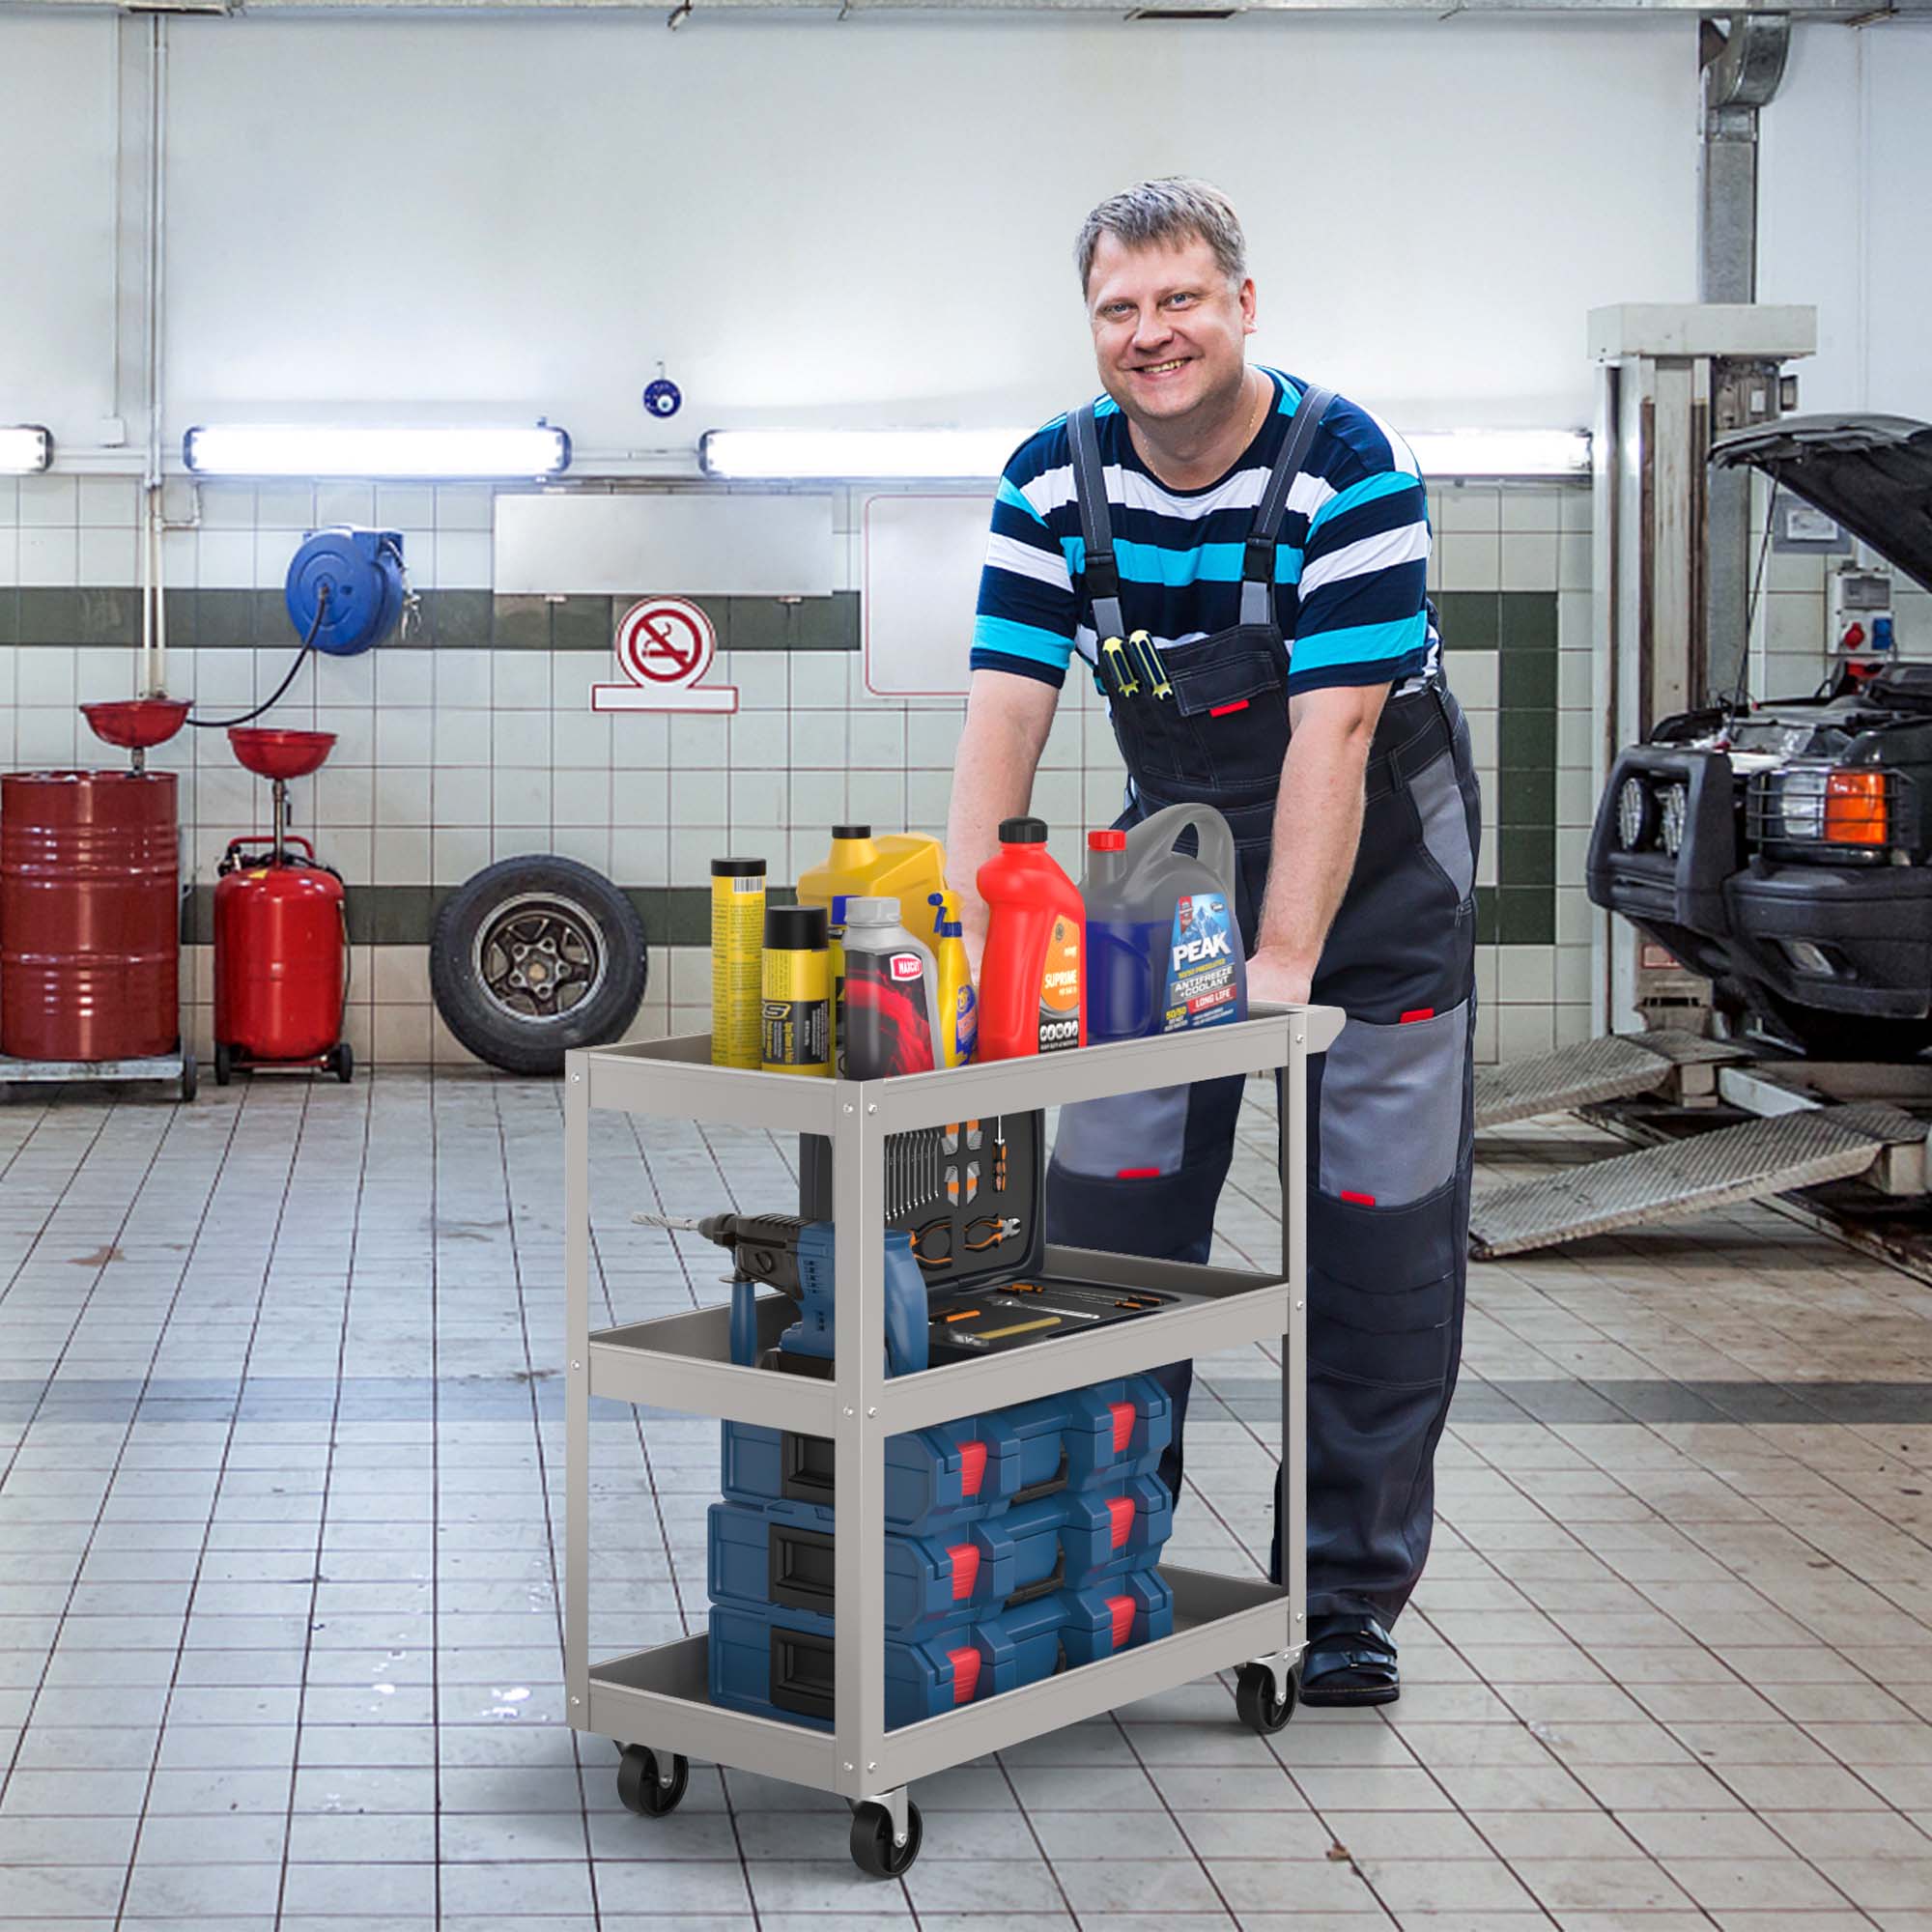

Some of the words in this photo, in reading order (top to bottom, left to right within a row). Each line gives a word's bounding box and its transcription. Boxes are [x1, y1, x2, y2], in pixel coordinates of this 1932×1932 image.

[1173, 931, 1231, 971] PEAK
[1175, 966, 1234, 992] ANTIFREEZE
[1195, 992, 1215, 1009] LONG
[1215, 988, 1231, 1004] LIFE
